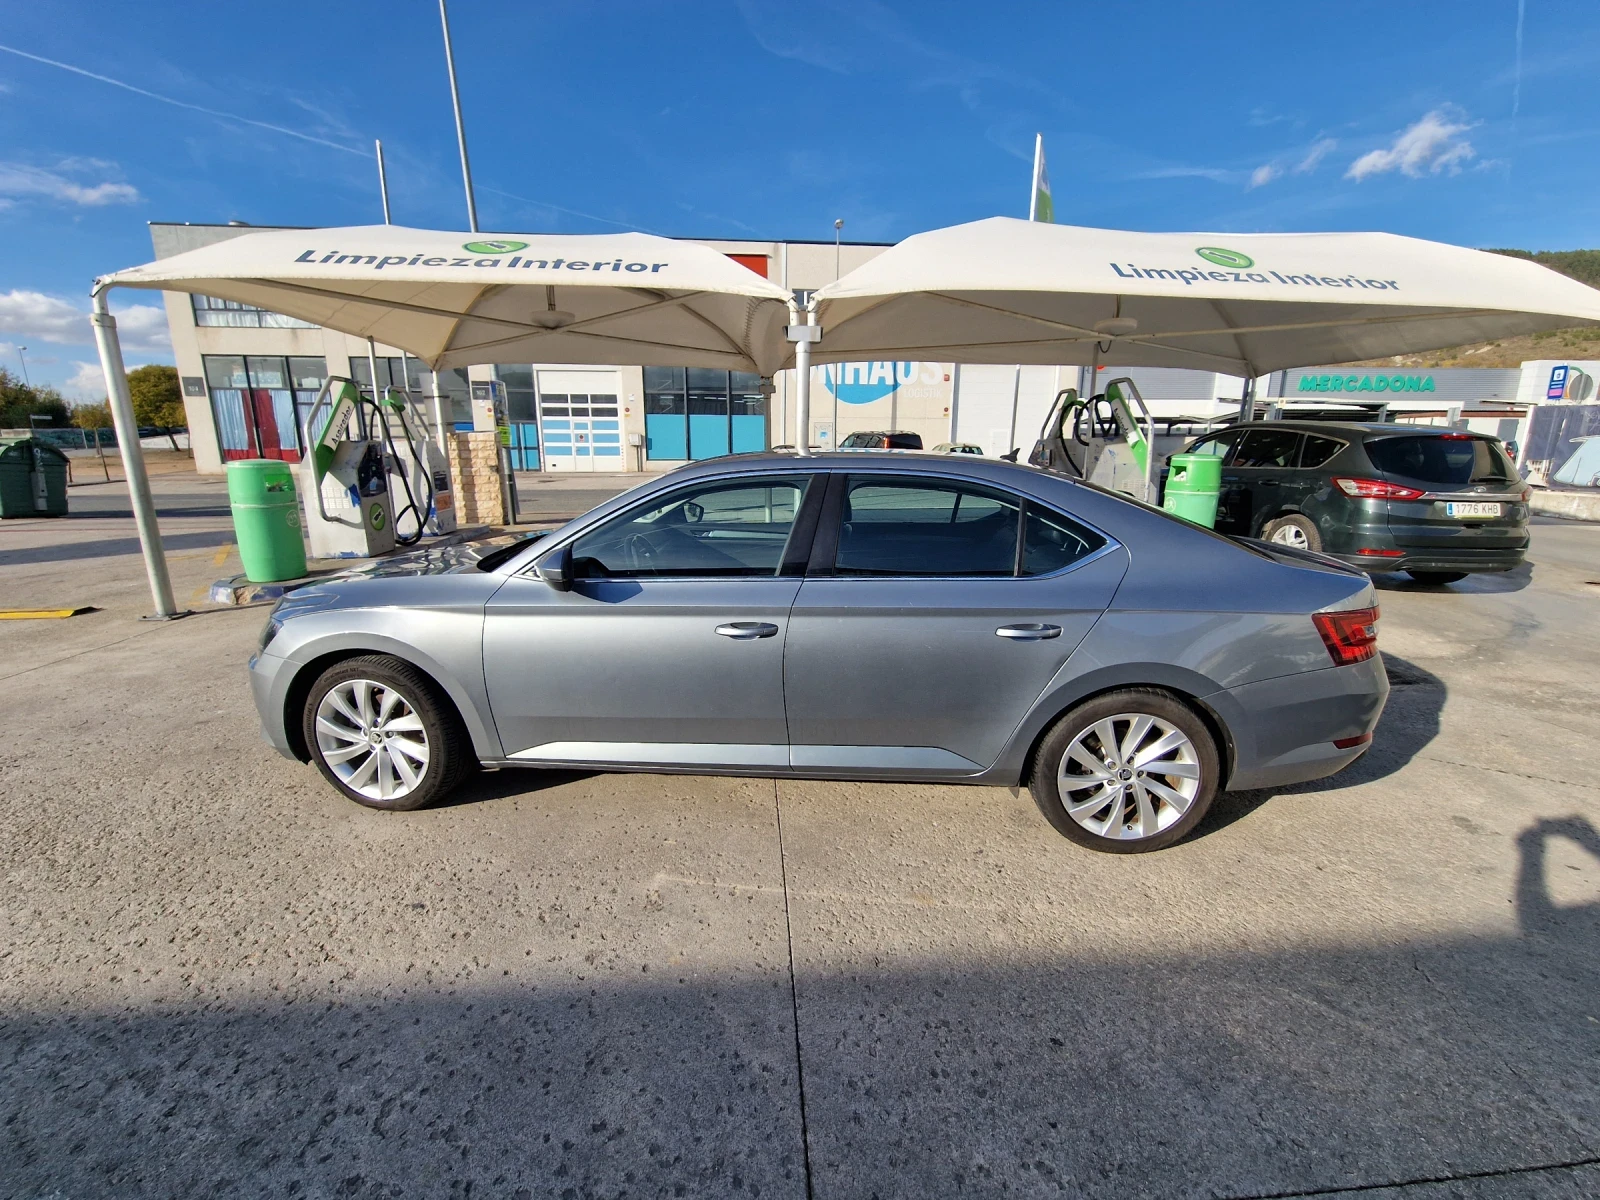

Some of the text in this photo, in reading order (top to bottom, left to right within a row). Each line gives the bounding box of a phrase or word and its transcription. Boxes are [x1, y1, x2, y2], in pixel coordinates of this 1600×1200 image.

[293, 250, 669, 272] Limpieza Interior
[1109, 262, 1400, 290] Limpieza Interior
[903, 387, 943, 398] LOGISTIK
[1298, 374, 1435, 393] MERCADONA
[331, 406, 352, 445] Aspirador
[1456, 504, 1499, 514] 1776 KHB
